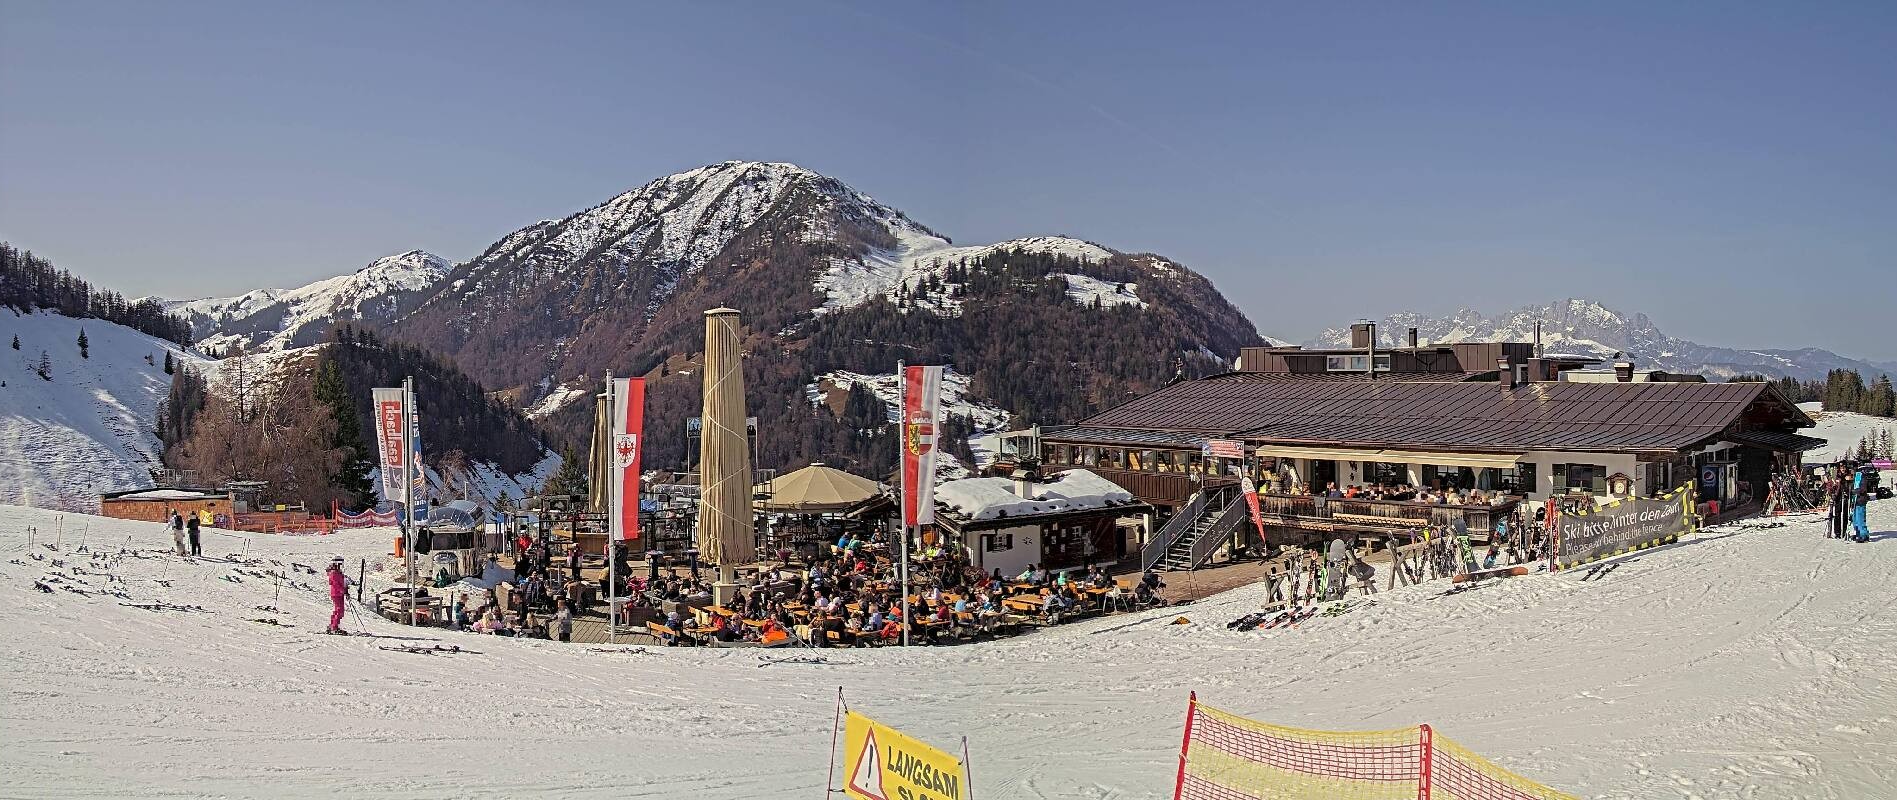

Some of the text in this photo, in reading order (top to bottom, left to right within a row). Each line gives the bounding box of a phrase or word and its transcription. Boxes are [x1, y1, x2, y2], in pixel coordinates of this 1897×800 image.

[1564, 502, 1680, 540] Ski bitte hinter den Zaun
[1566, 540, 1592, 556] Please
[1603, 527, 1631, 544] behind
[1631, 526, 1642, 539] the
[1642, 523, 1663, 535] fence
[887, 745, 959, 800] LANGSAM
